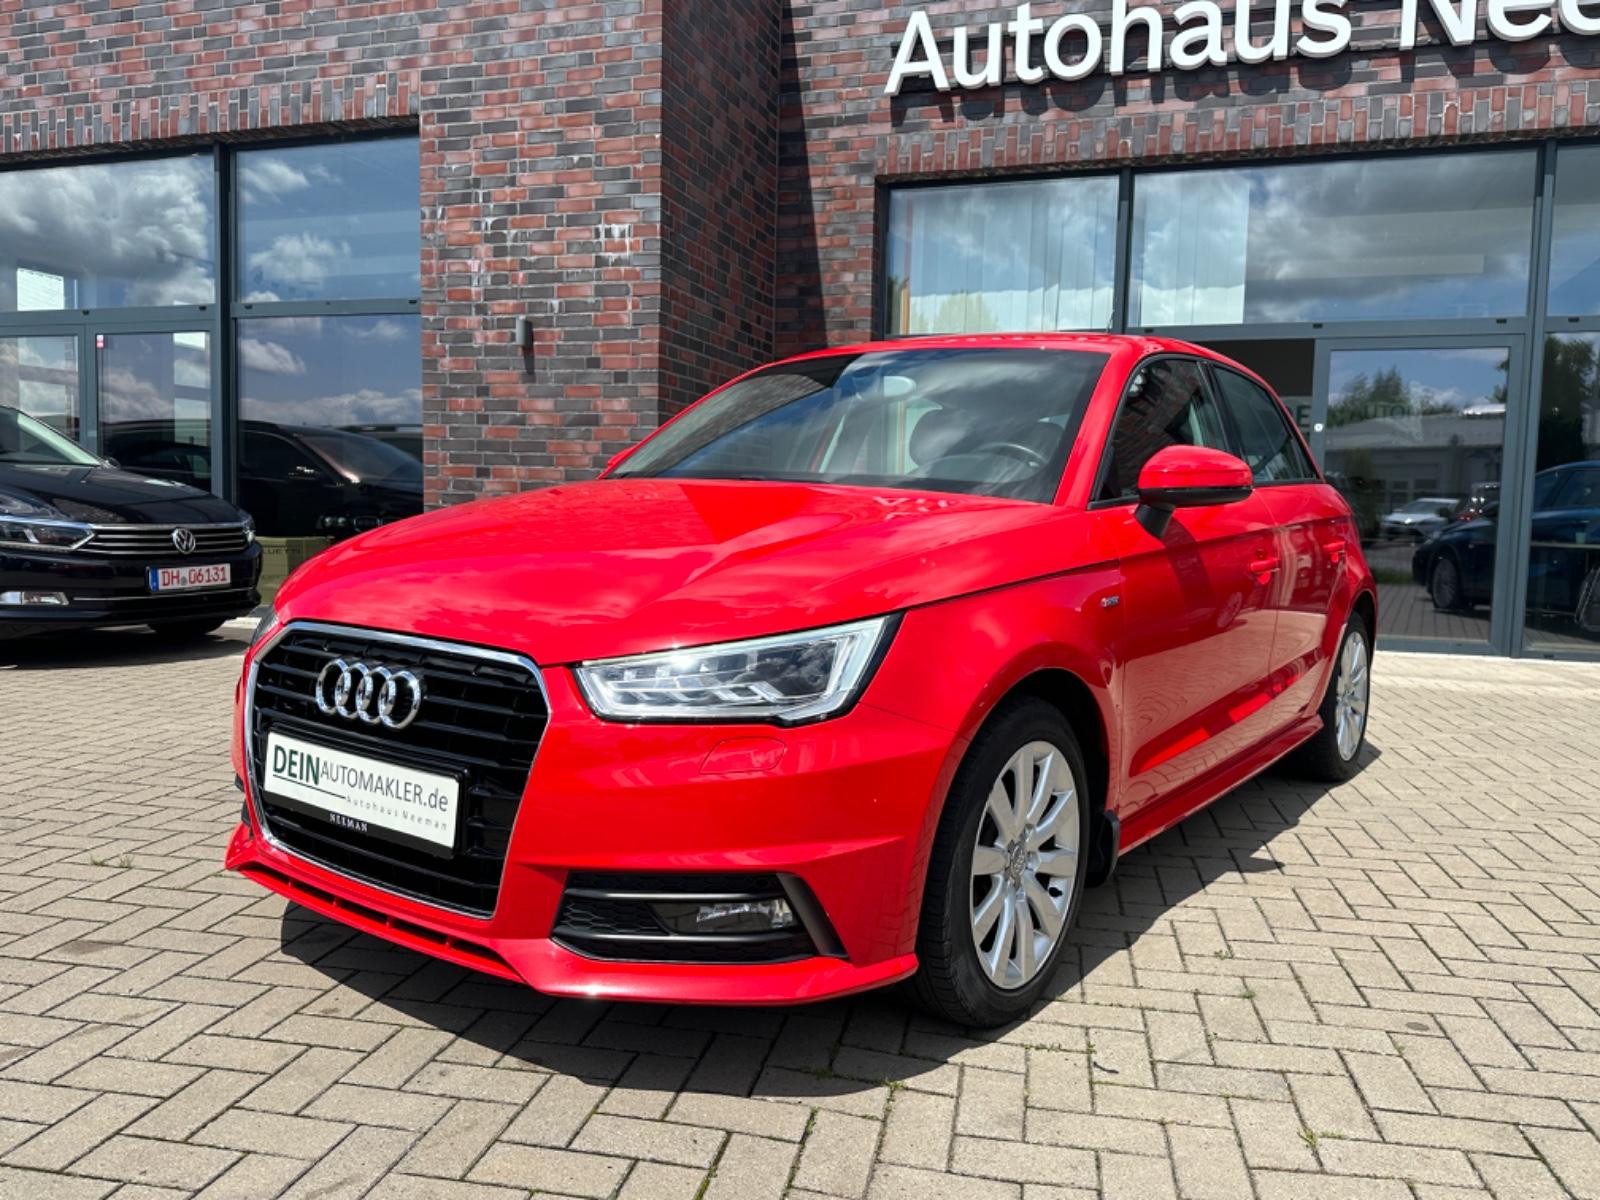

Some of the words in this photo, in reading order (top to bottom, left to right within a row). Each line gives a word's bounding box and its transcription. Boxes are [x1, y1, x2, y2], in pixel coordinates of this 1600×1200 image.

[883, 0, 1352, 95] Autohaus
[161, 569, 180, 587] DH
[188, 566, 227, 585] 06131
[272, 744, 449, 812] DEINAUTOMAKLER.de
[329, 812, 368, 832] NEEMAN
[346, 795, 398, 817] Autohaus
[402, 809, 448, 831] Neeman
